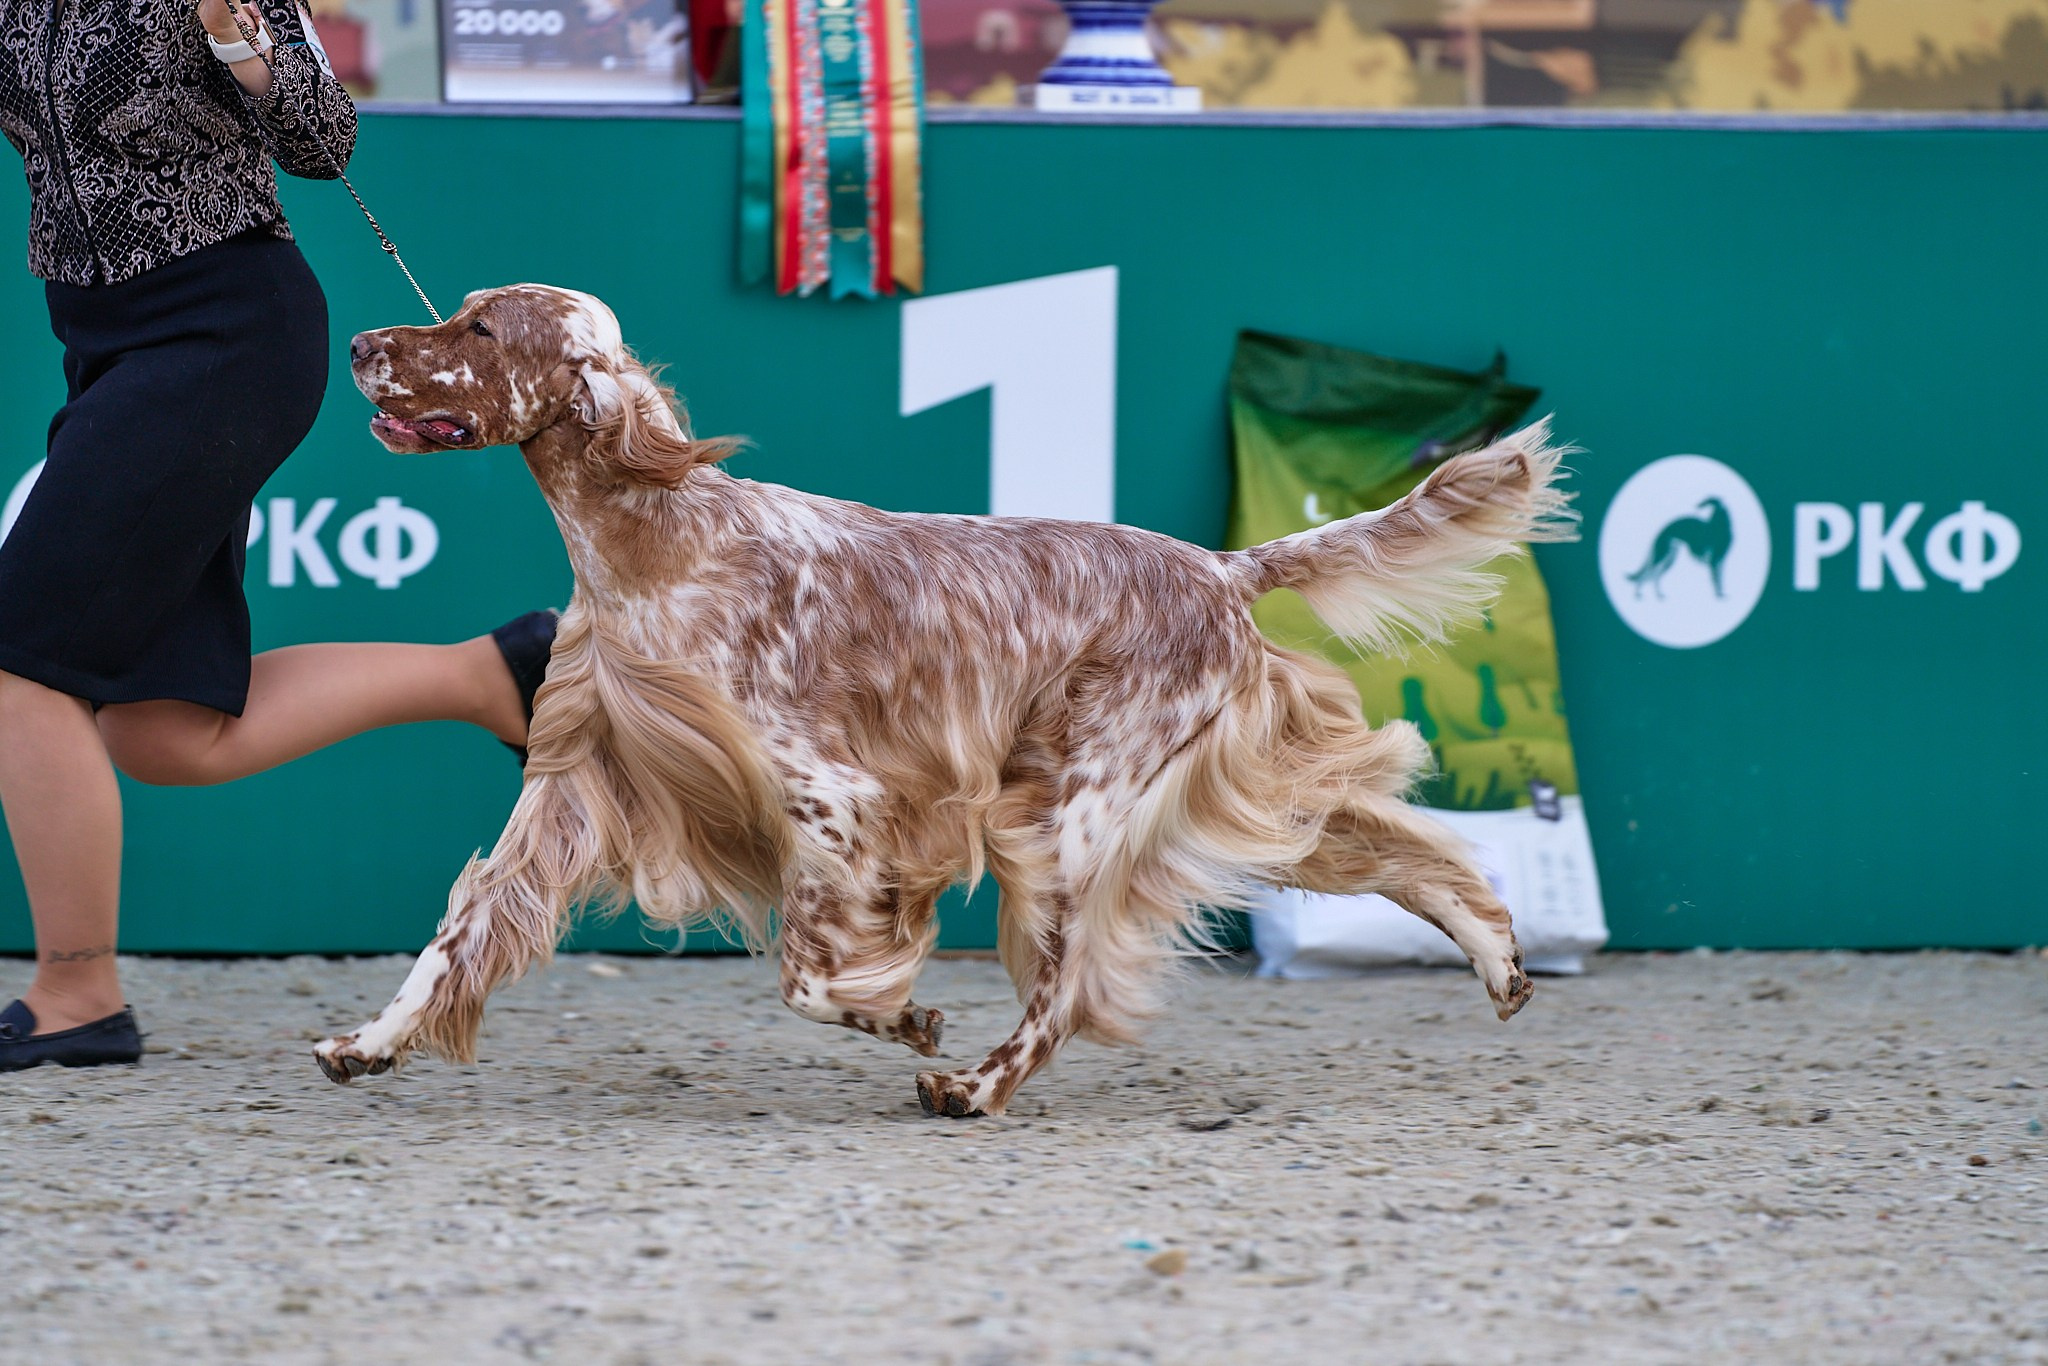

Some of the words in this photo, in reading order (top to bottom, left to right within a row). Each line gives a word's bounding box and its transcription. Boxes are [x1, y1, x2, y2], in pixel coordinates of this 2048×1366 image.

[900, 265, 1119, 523] 1
[247, 496, 439, 589] КФ
[1794, 501, 2021, 592] РКФ
